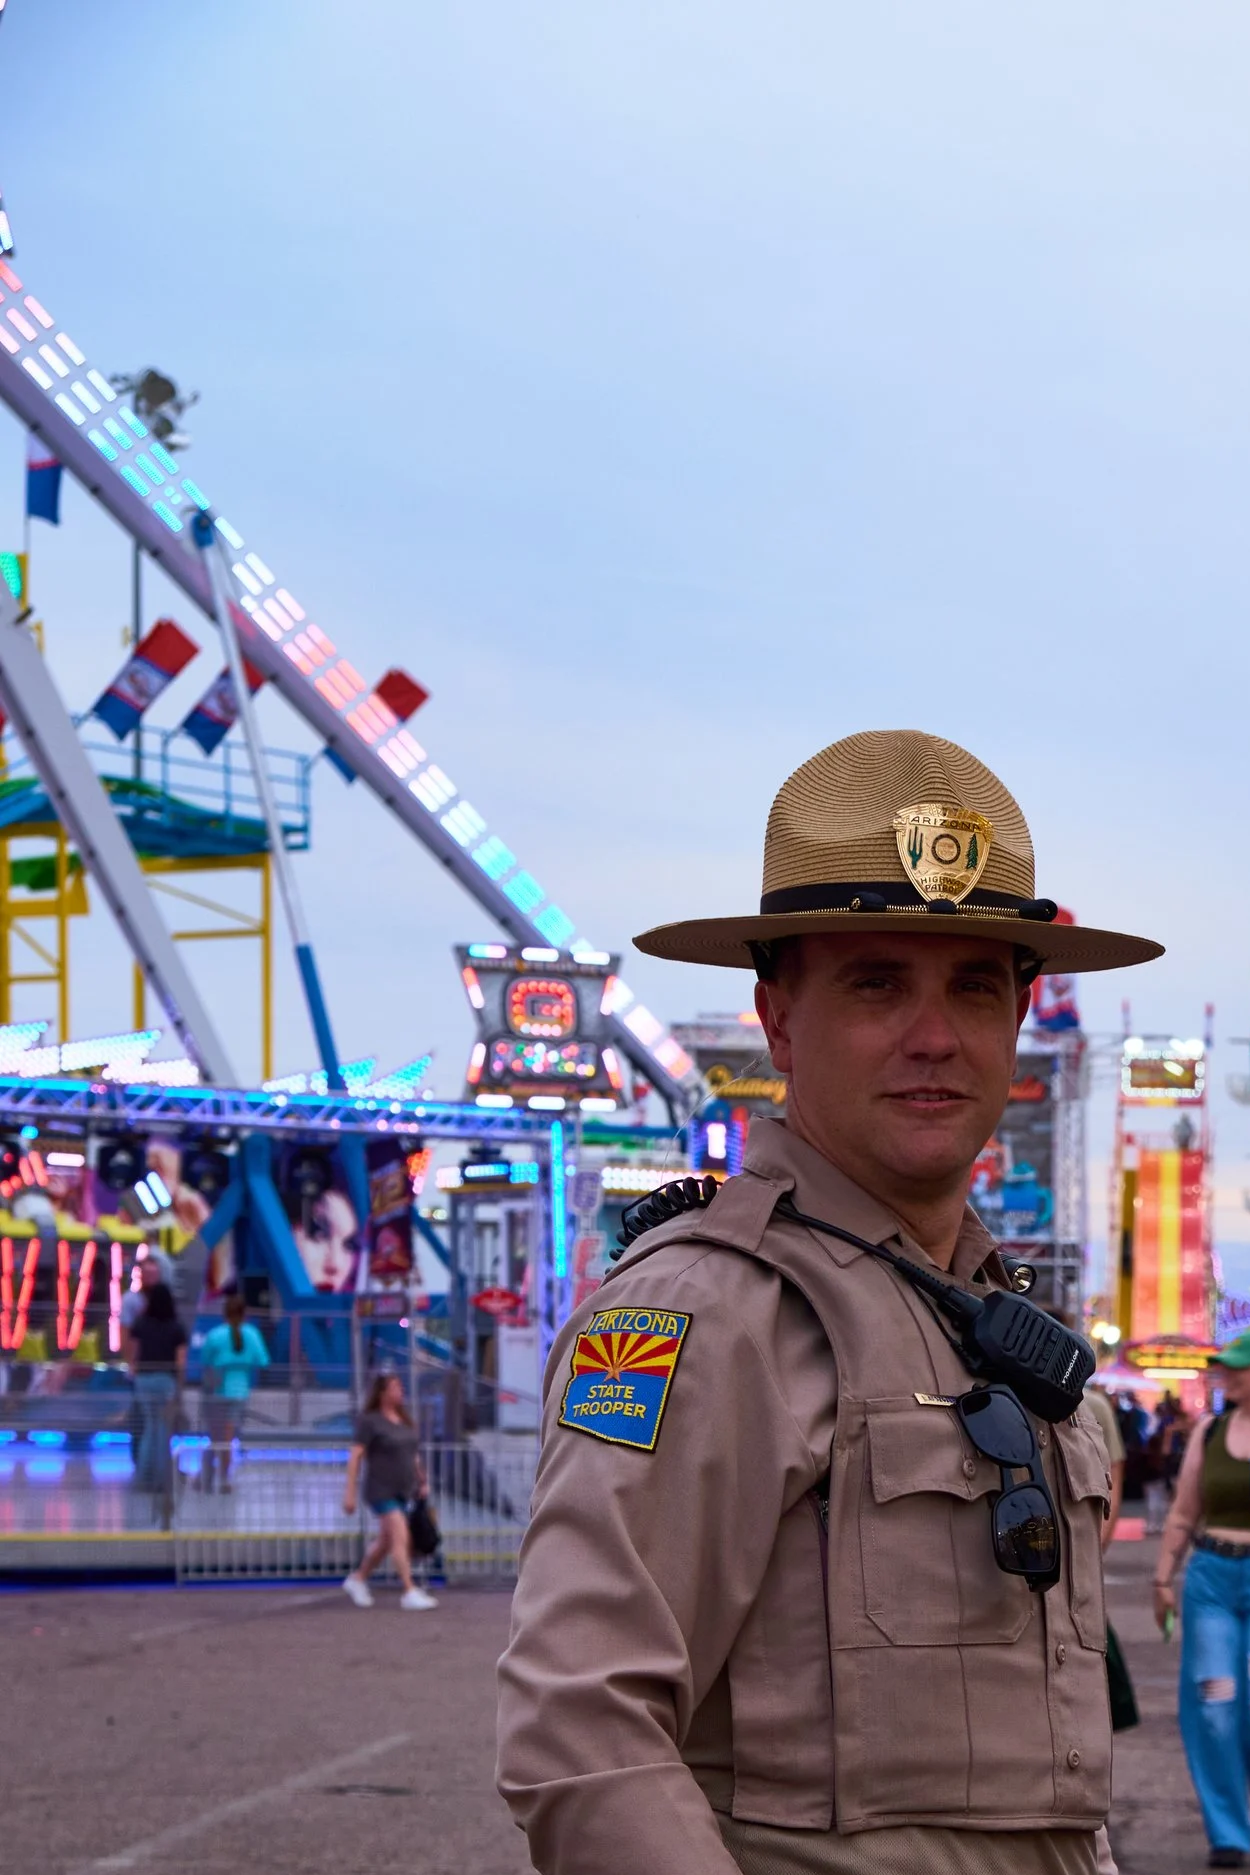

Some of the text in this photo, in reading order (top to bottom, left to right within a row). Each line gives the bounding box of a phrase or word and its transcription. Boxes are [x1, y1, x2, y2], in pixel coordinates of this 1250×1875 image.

[910, 815, 980, 832] ARIZONA
[594, 1313, 678, 1336] ARIZONA
[1061, 1349, 1079, 1384] MOTOROLA
[586, 1384, 636, 1400] STATE
[572, 1401, 648, 1420] TROOPER
